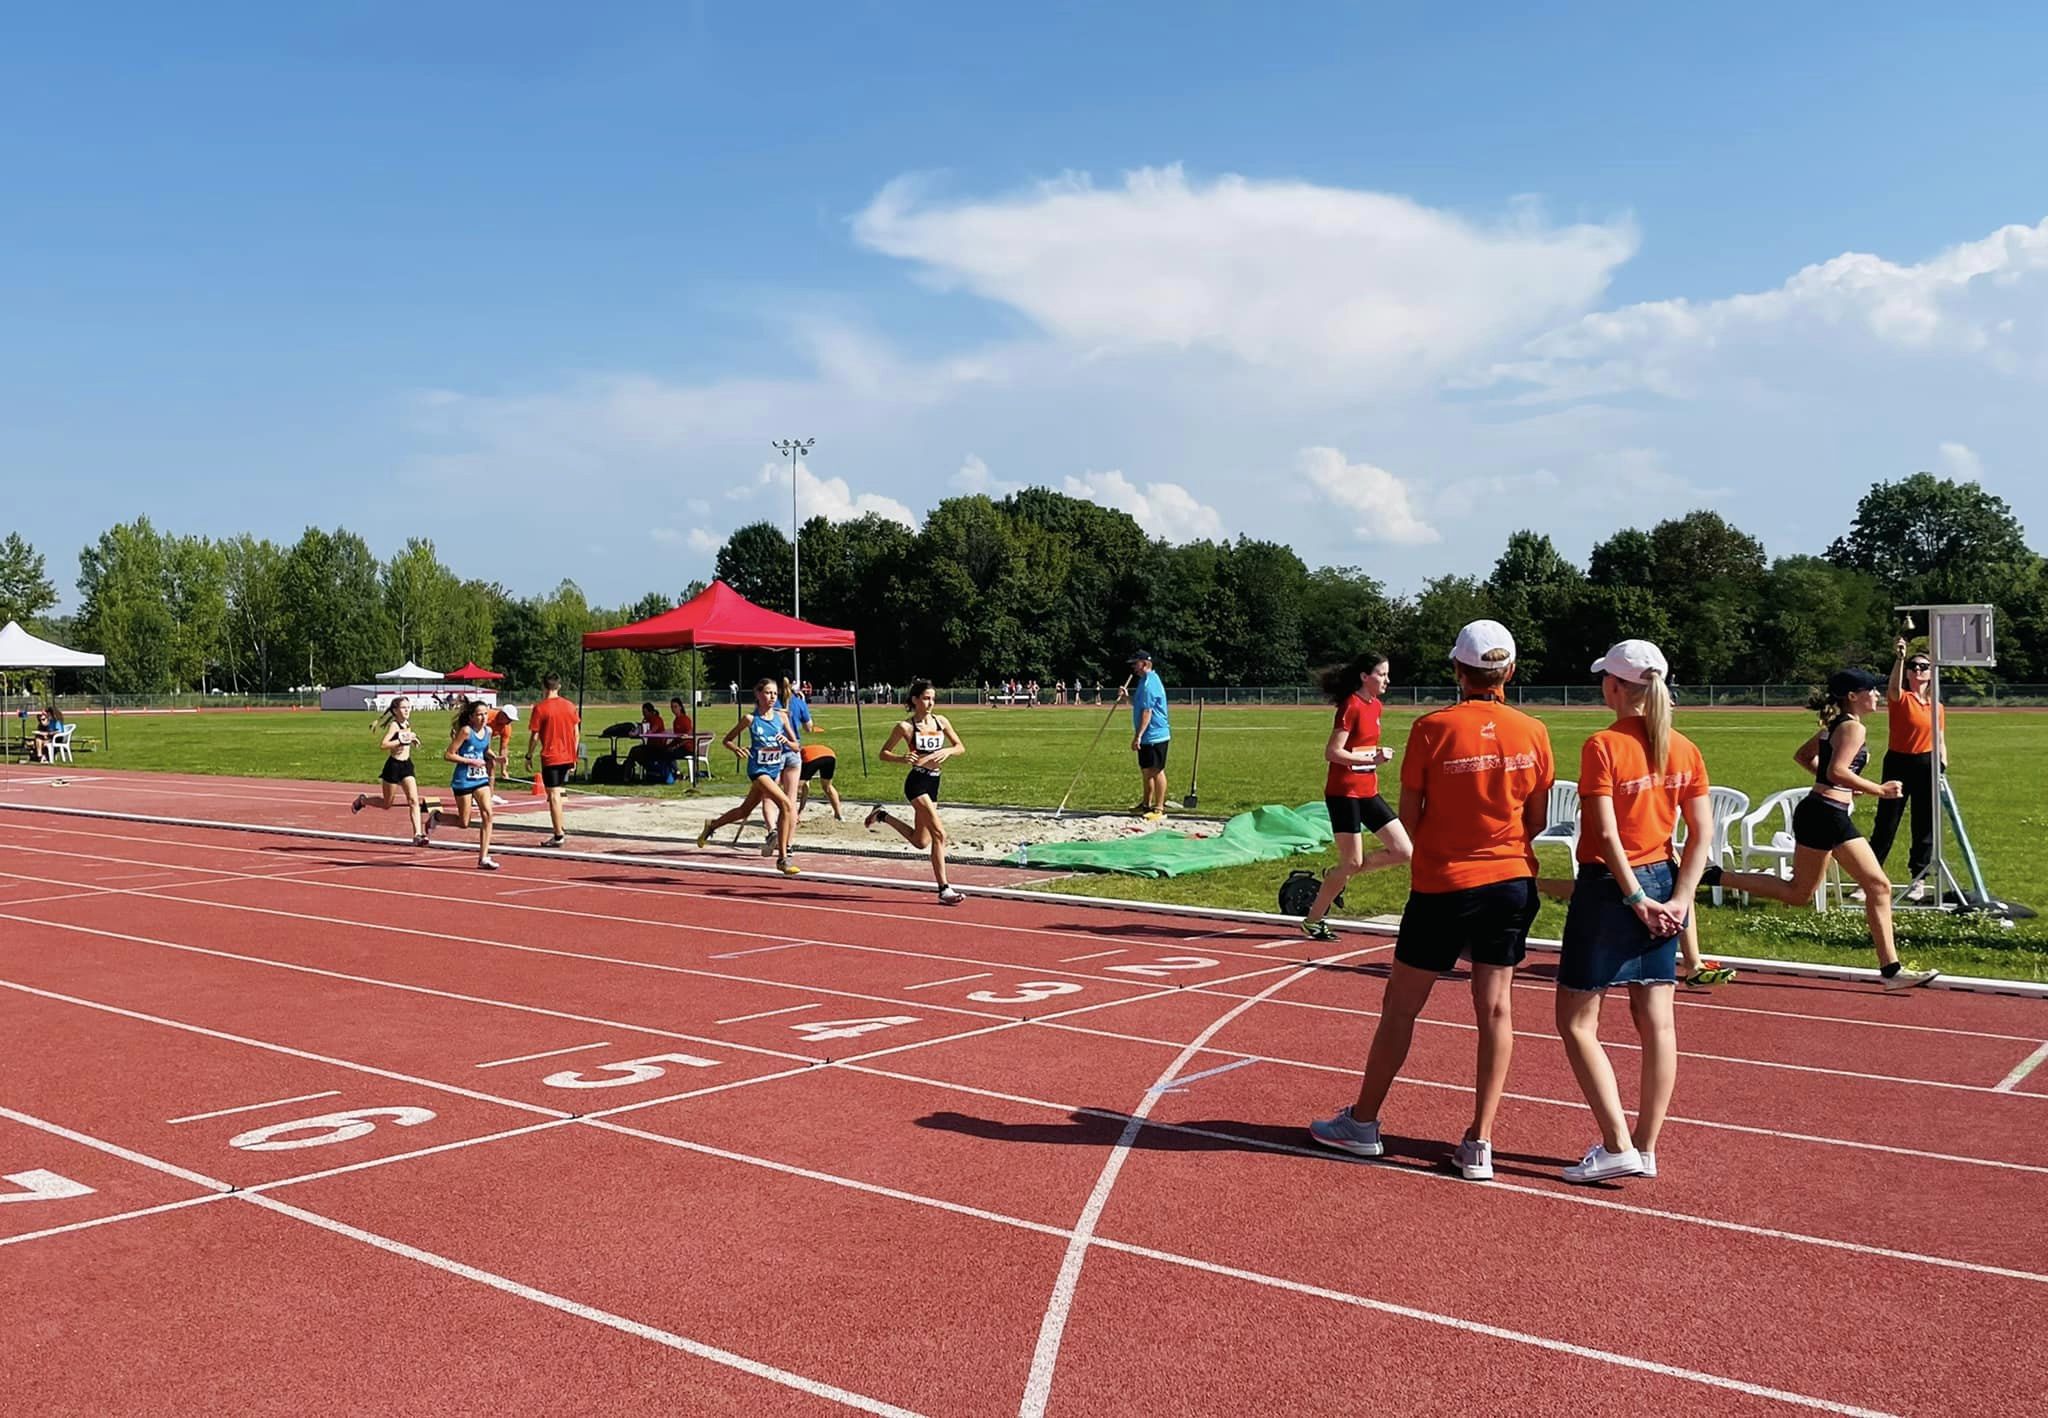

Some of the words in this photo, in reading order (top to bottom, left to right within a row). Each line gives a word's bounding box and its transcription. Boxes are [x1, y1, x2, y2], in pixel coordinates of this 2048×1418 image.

[1969, 614, 1982, 653] 1
[920, 737, 939, 749] 161
[1103, 956, 1220, 976] 2
[966, 981, 1083, 1003] 3
[788, 1015, 923, 1042] 4
[542, 1053, 724, 1089] 5
[229, 1106, 437, 1151] 6
